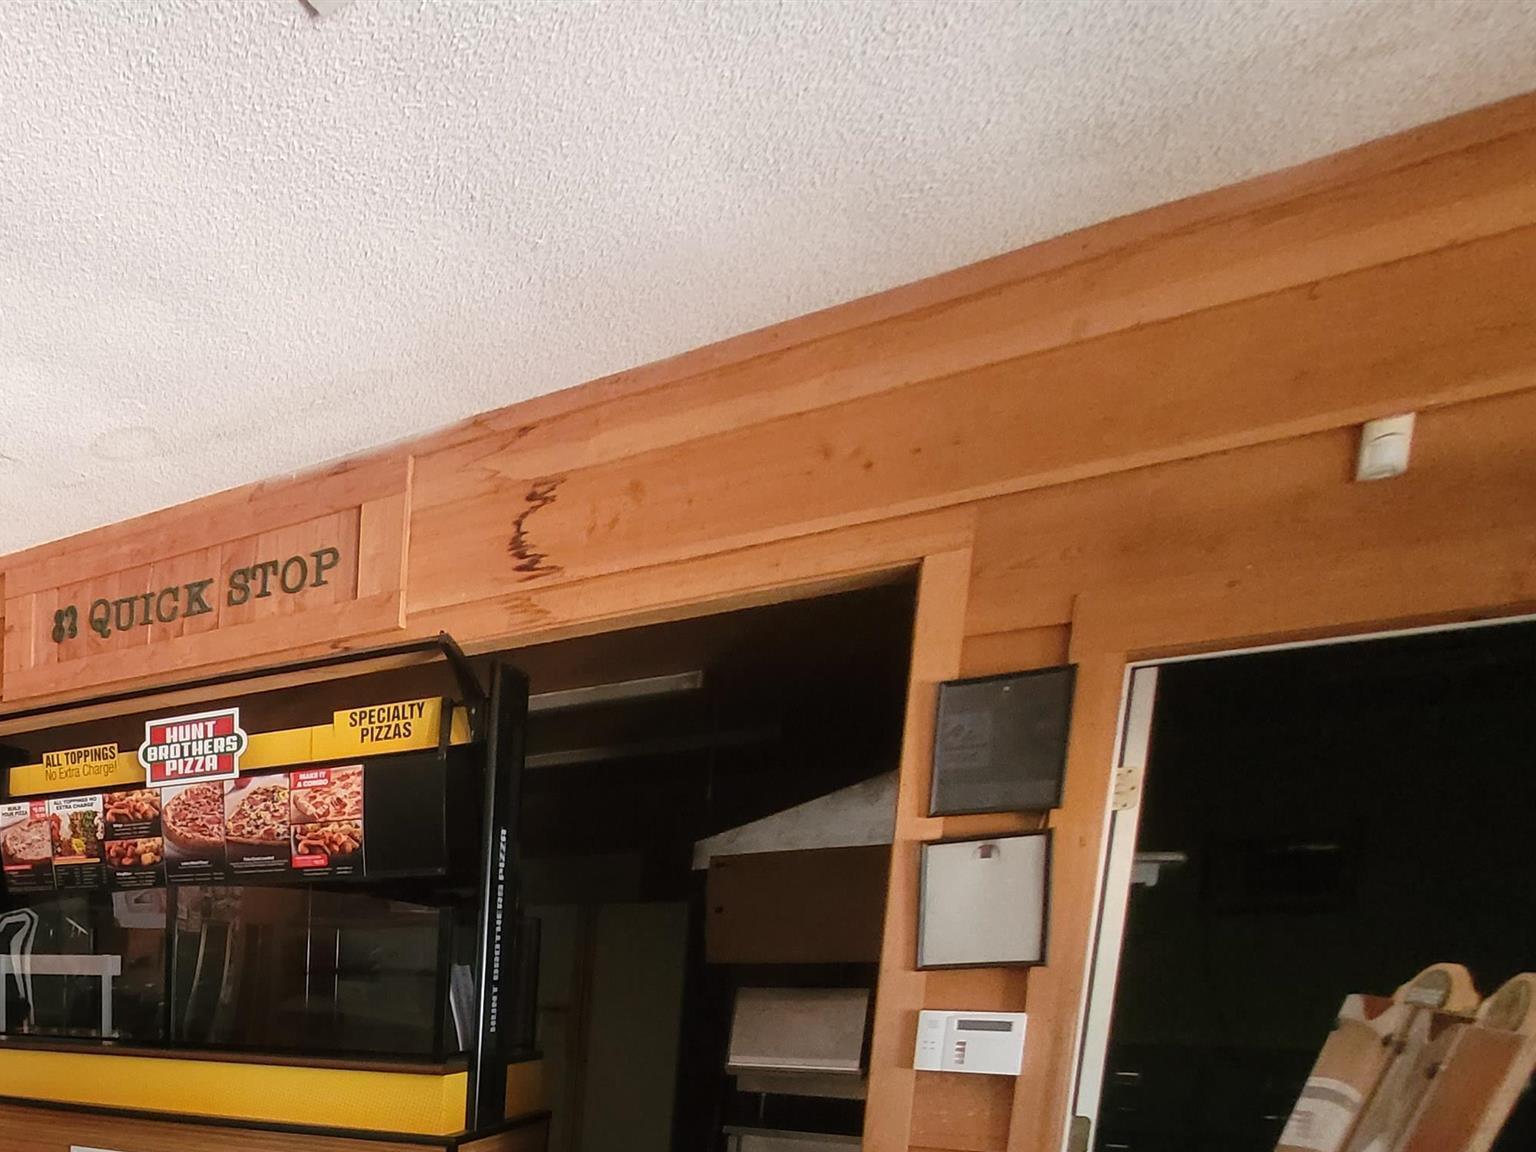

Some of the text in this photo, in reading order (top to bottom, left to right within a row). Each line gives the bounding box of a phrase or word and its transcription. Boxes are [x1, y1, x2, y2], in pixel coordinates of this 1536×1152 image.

[88, 578, 214, 639] QUICK
[227, 547, 340, 607] STOP
[349, 701, 425, 727] SPECIALTY
[166, 720, 217, 744] HUNT
[360, 722, 412, 743] PIZZAS
[45, 746, 116, 769] ALL TOPPINGS
[147, 735, 238, 762] BROTHERS
[45, 761, 118, 781] No Extra Charge!
[165, 754, 218, 776] PIZZA
